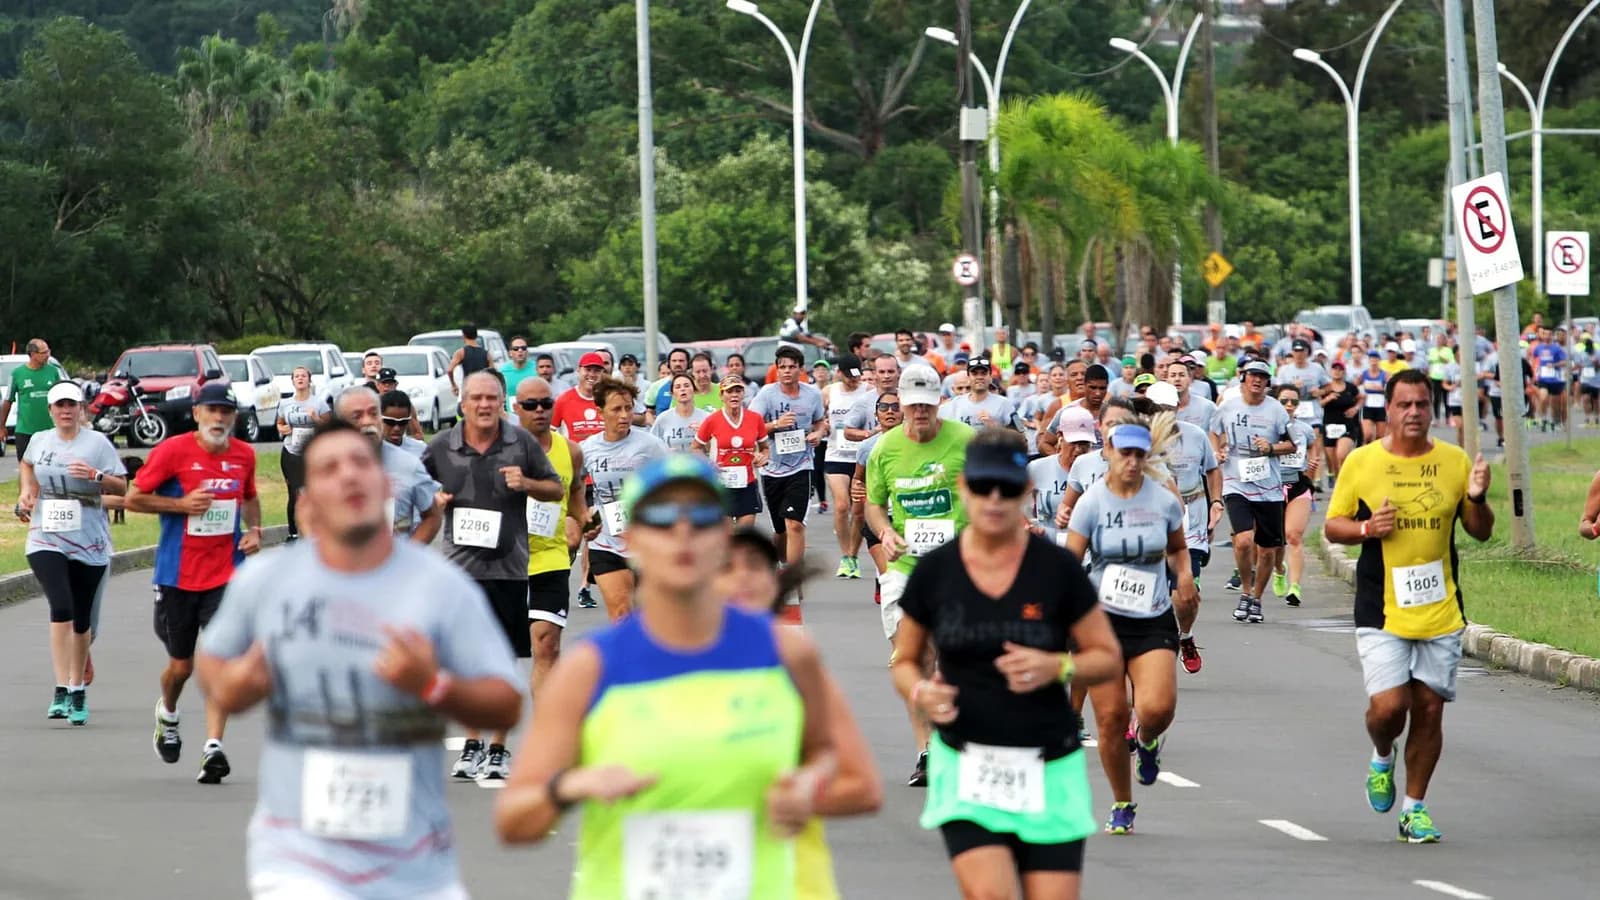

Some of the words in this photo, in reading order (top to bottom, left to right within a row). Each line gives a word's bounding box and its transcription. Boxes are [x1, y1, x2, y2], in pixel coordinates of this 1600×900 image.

[1246, 465, 1265, 475] 2061
[47, 510, 74, 520] 2285
[532, 511, 551, 524] 371
[460, 519, 491, 533] 2286
[913, 531, 946, 545] 2273
[1113, 578, 1146, 597] 1648
[1406, 575, 1439, 592] 1805
